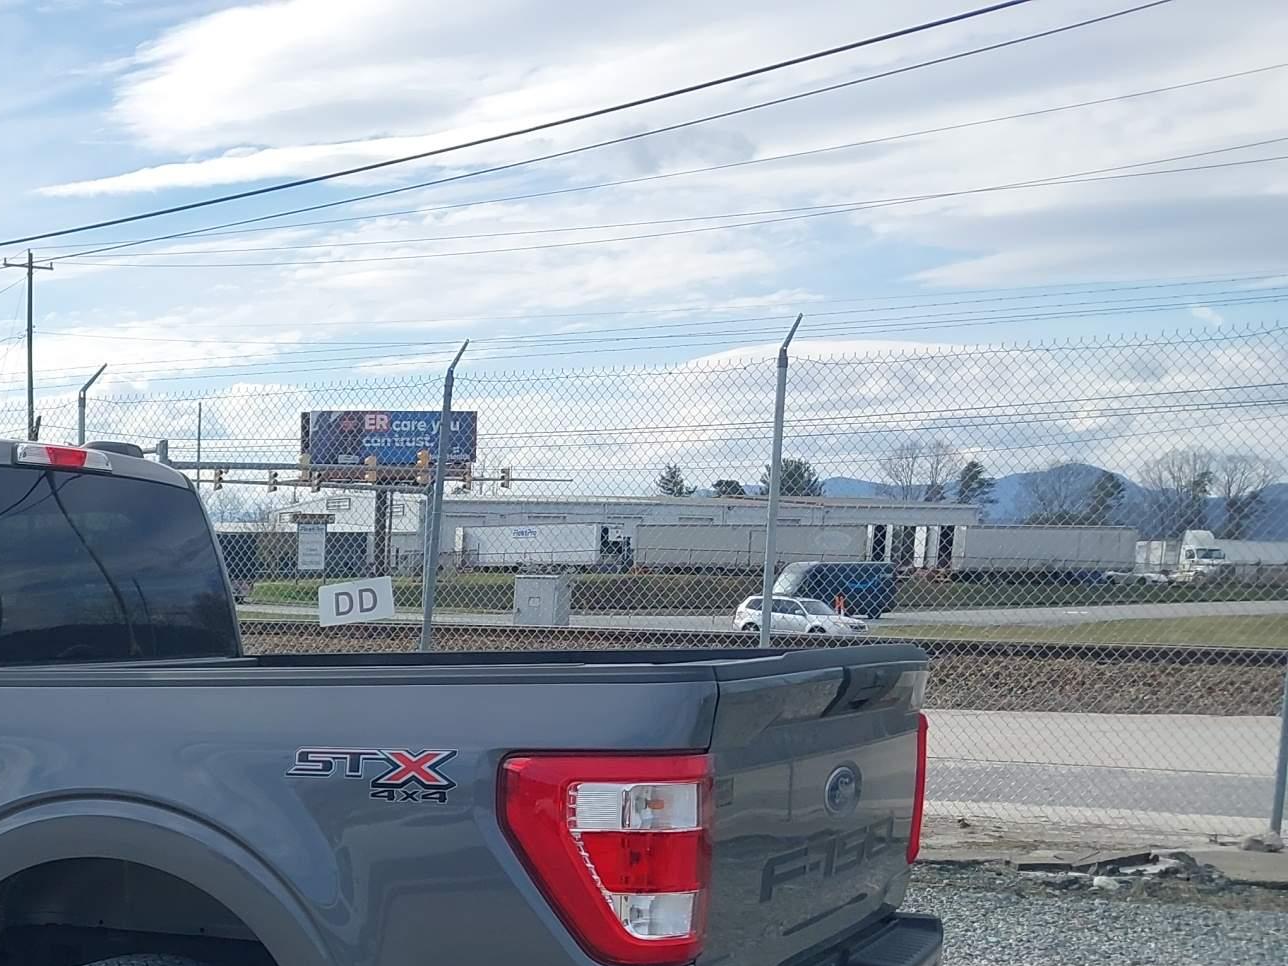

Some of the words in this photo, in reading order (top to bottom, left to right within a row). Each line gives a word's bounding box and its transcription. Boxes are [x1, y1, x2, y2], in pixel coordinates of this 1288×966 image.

[364, 414, 389, 430] ER
[392, 419, 427, 431] care
[431, 419, 460, 434] yu
[362, 435, 392, 447] can
[285, 746, 459, 791] STX
